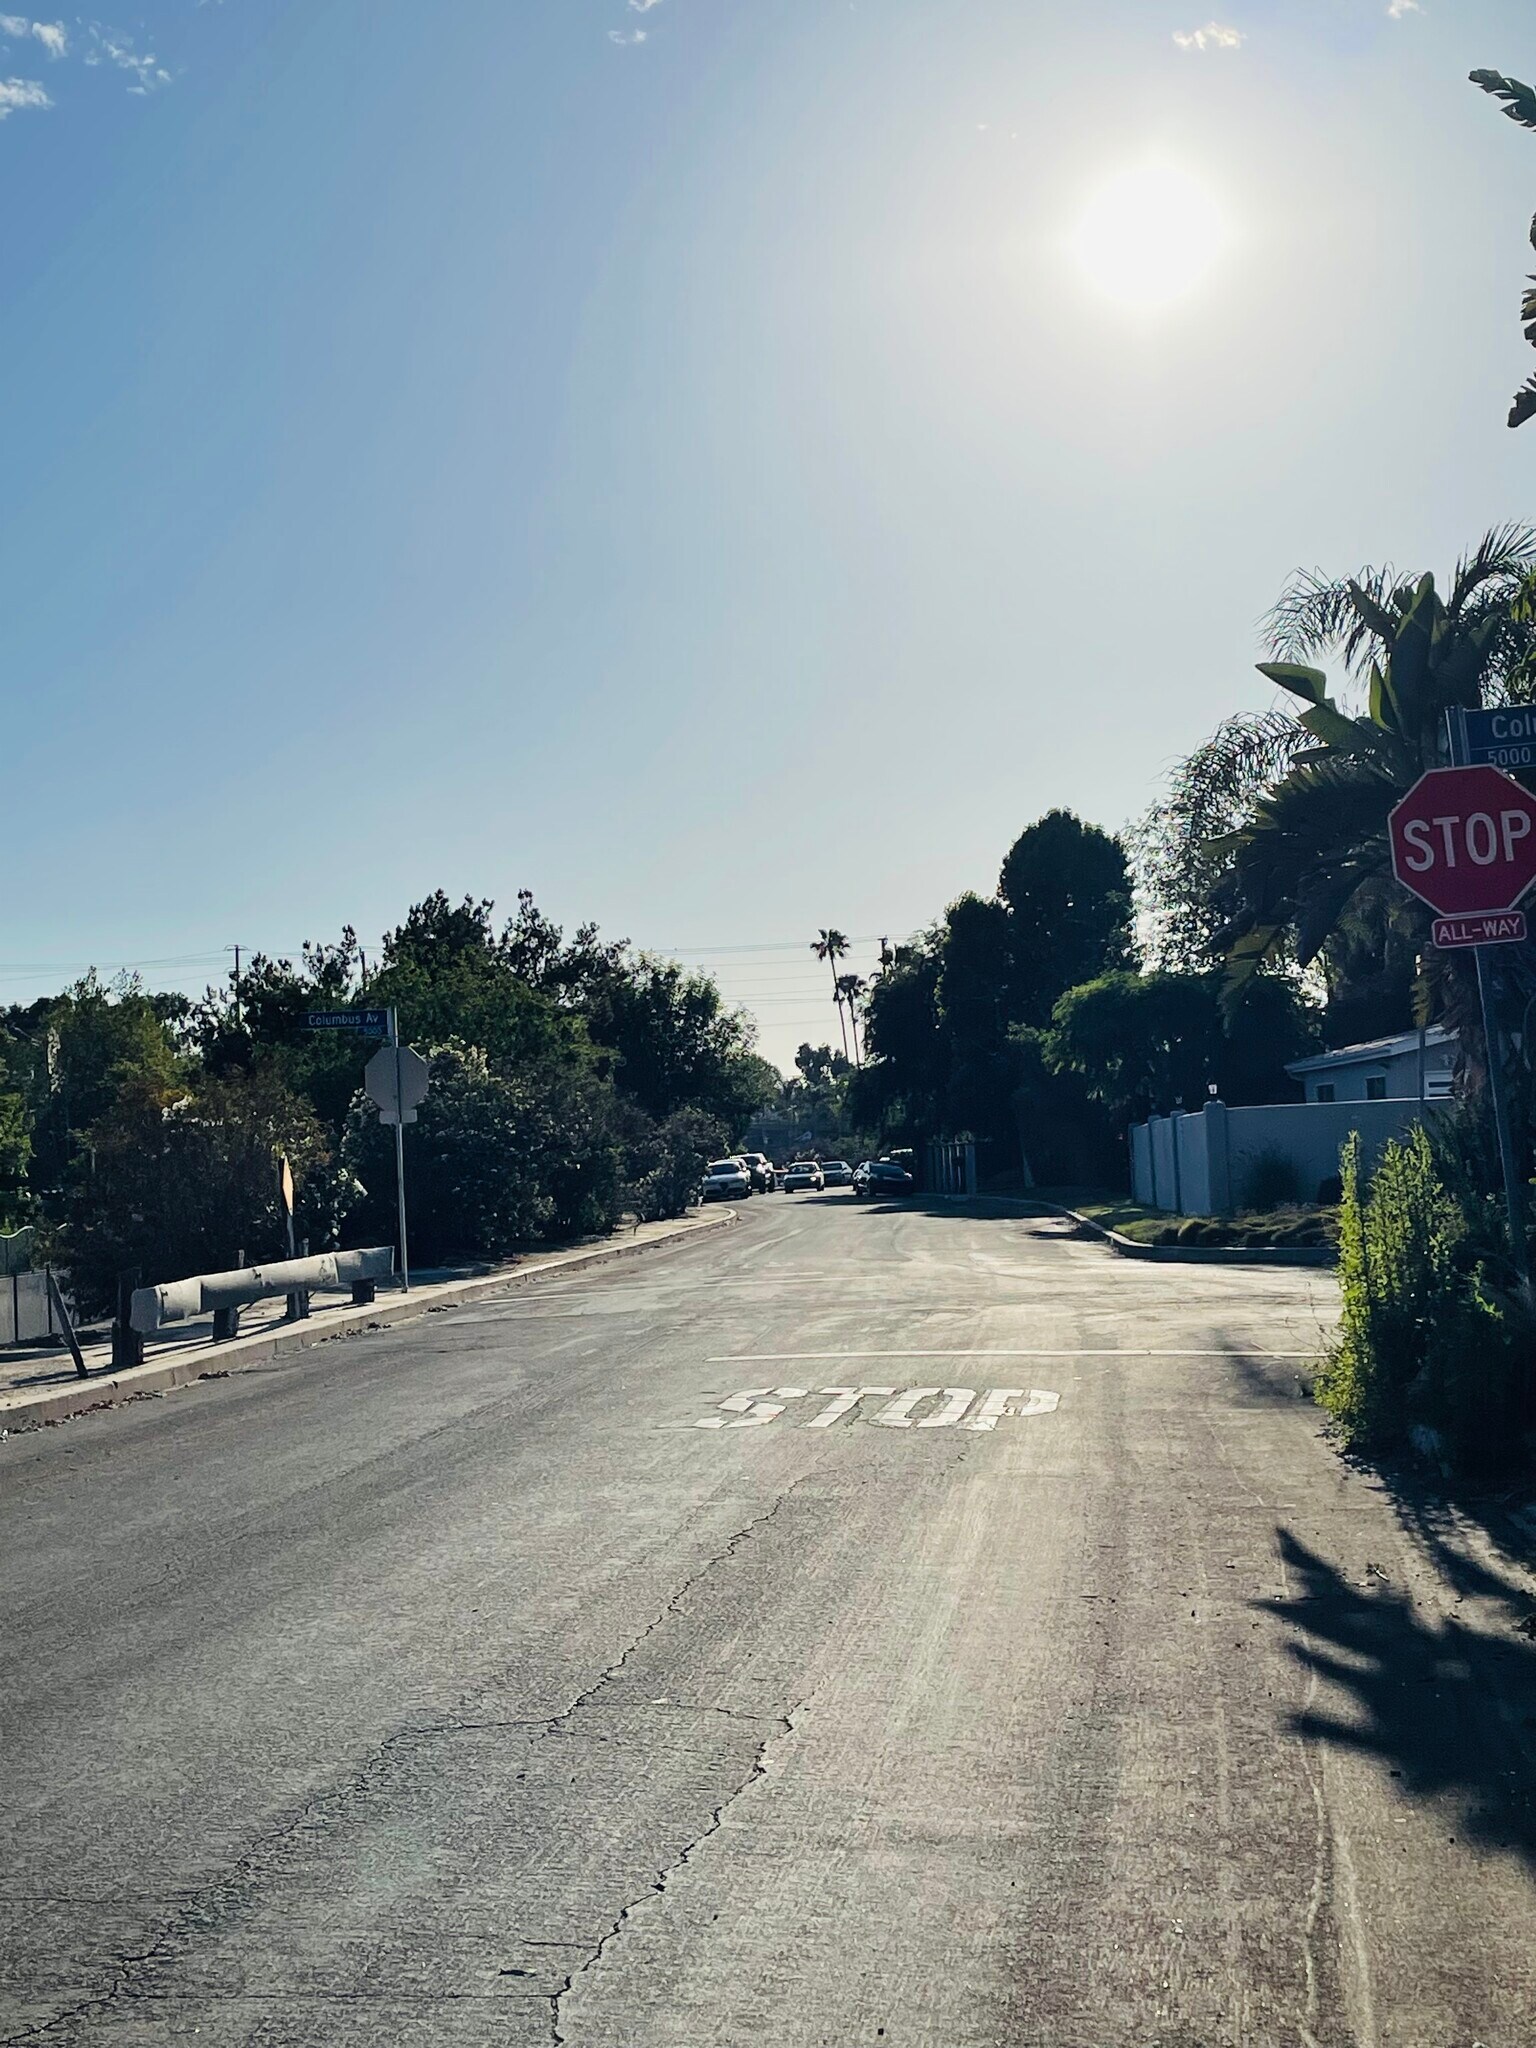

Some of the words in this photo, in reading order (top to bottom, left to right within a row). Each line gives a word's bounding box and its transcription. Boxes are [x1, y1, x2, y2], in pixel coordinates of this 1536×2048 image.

[1487, 747, 1531, 765] 5000
[1403, 809, 1531, 872] STOP
[1438, 917, 1521, 942] ALL-WAY
[308, 1014, 361, 1026] Columbus
[366, 1012, 379, 1024] Av
[690, 1385, 1062, 1431] STOP
